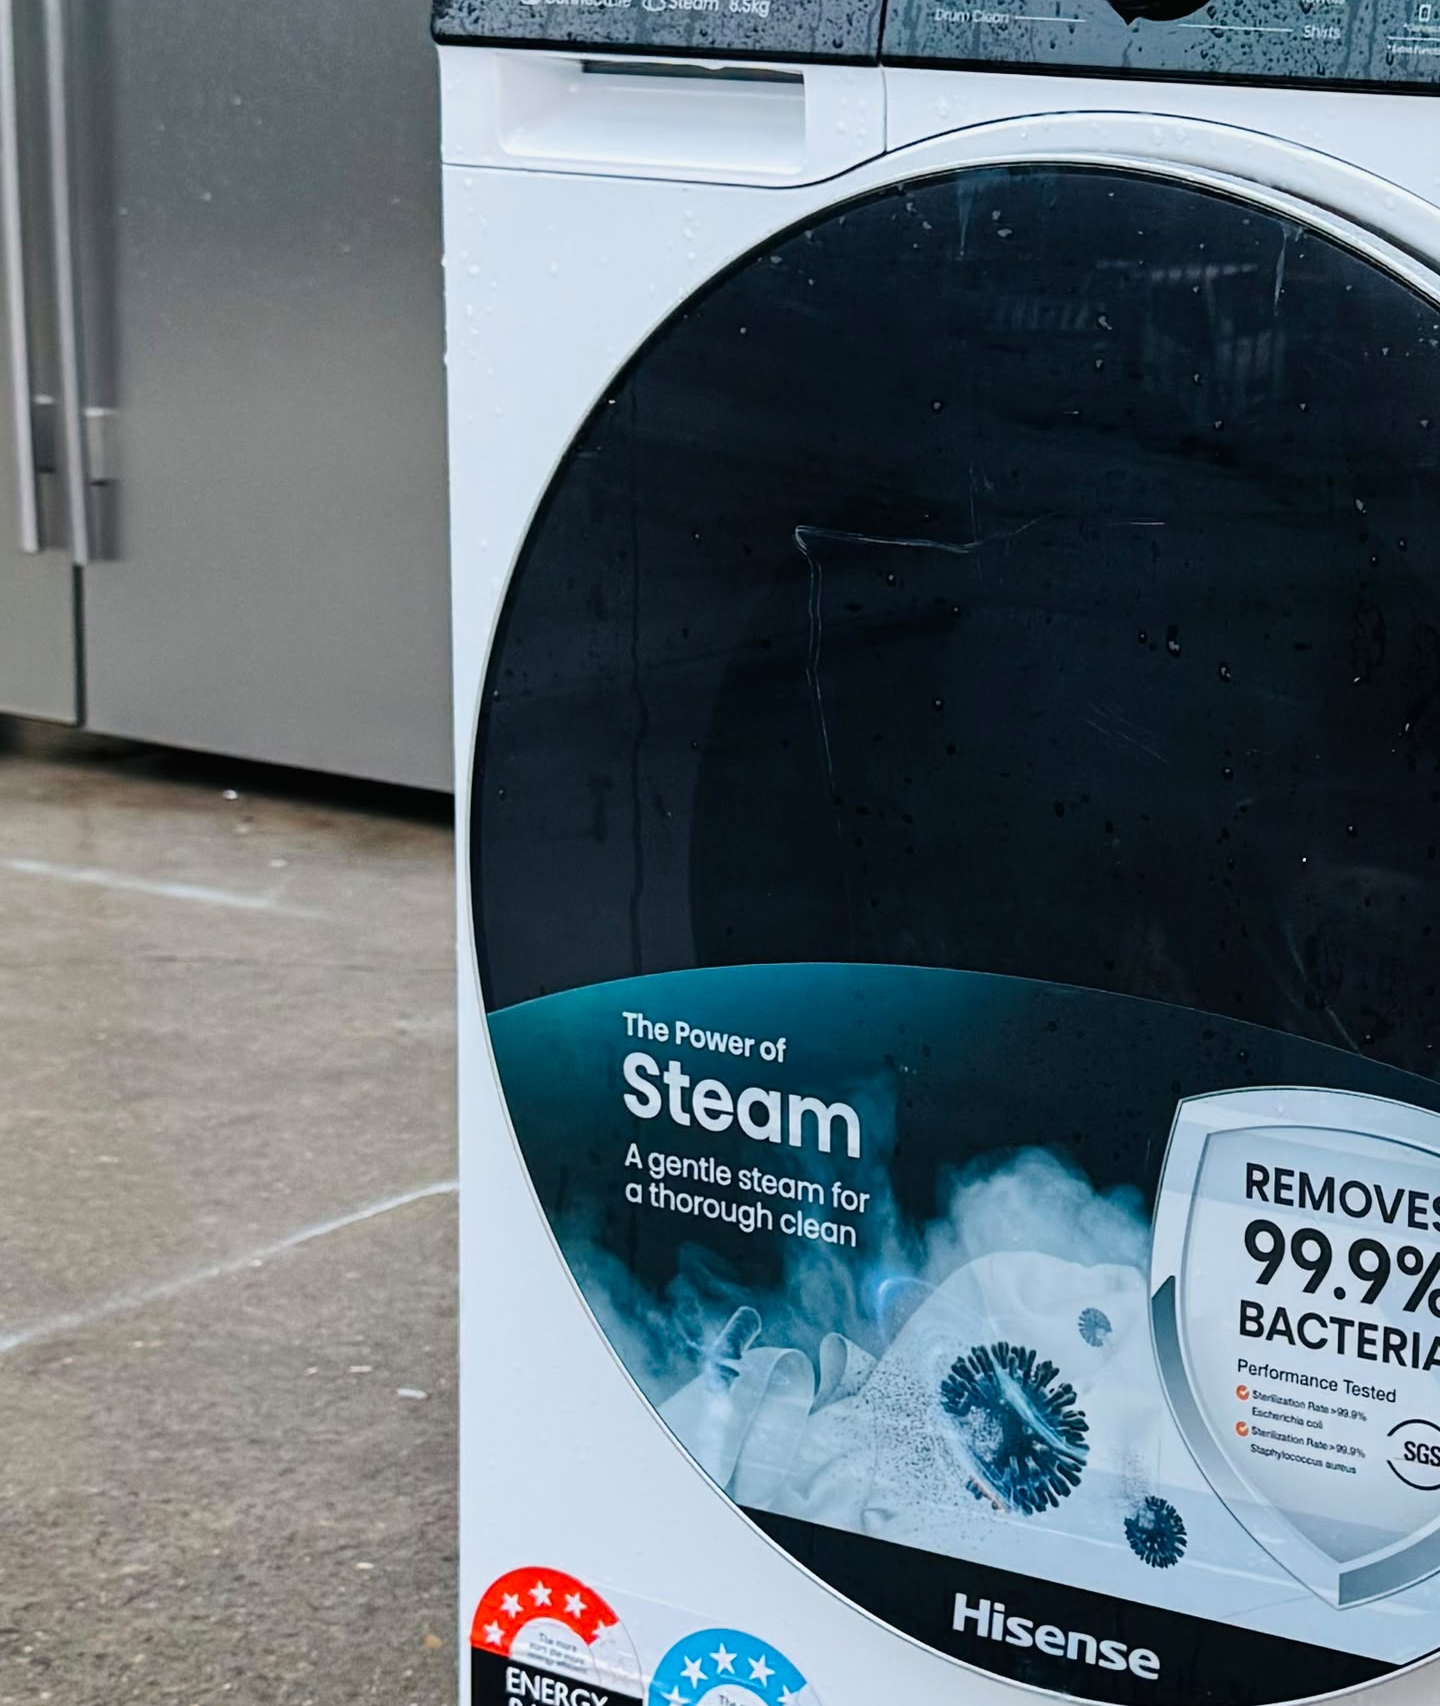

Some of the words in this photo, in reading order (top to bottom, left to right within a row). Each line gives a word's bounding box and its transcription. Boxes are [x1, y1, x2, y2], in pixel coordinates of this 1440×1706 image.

[934, 8, 970, 22] Drum
[972, 9, 1010, 24] Clean
[1303, 24, 1342, 40] Shirts
[622, 1011, 670, 1042] The
[675, 1020, 755, 1058] Power
[759, 1037, 787, 1064] of
[622, 1051, 861, 1159] Steam
[624, 1143, 643, 1170] A
[647, 1151, 732, 1187] gentle
[738, 1166, 825, 1206] steam
[831, 1181, 871, 1214] for
[625, 1182, 643, 1205] a
[648, 1182, 773, 1234] thorough
[779, 1210, 857, 1248] clean
[1237, 1358, 1339, 1392] Performance
[1343, 1379, 1397, 1403] Tested
[1251, 1406, 1305, 1427] Escherichia
[1306, 1419, 1324, 1430] coli
[1252, 1389, 1306, 1410] Sterilization
[1308, 1401, 1330, 1415] Rate
[1251, 1426, 1305, 1446] Sterilization
[1306, 1437, 1329, 1451] Rate
[1250, 1443, 1324, 1468] Staphylococcus
[1325, 1463, 1358, 1475] aureus
[952, 1592, 1161, 1681] Hisense
